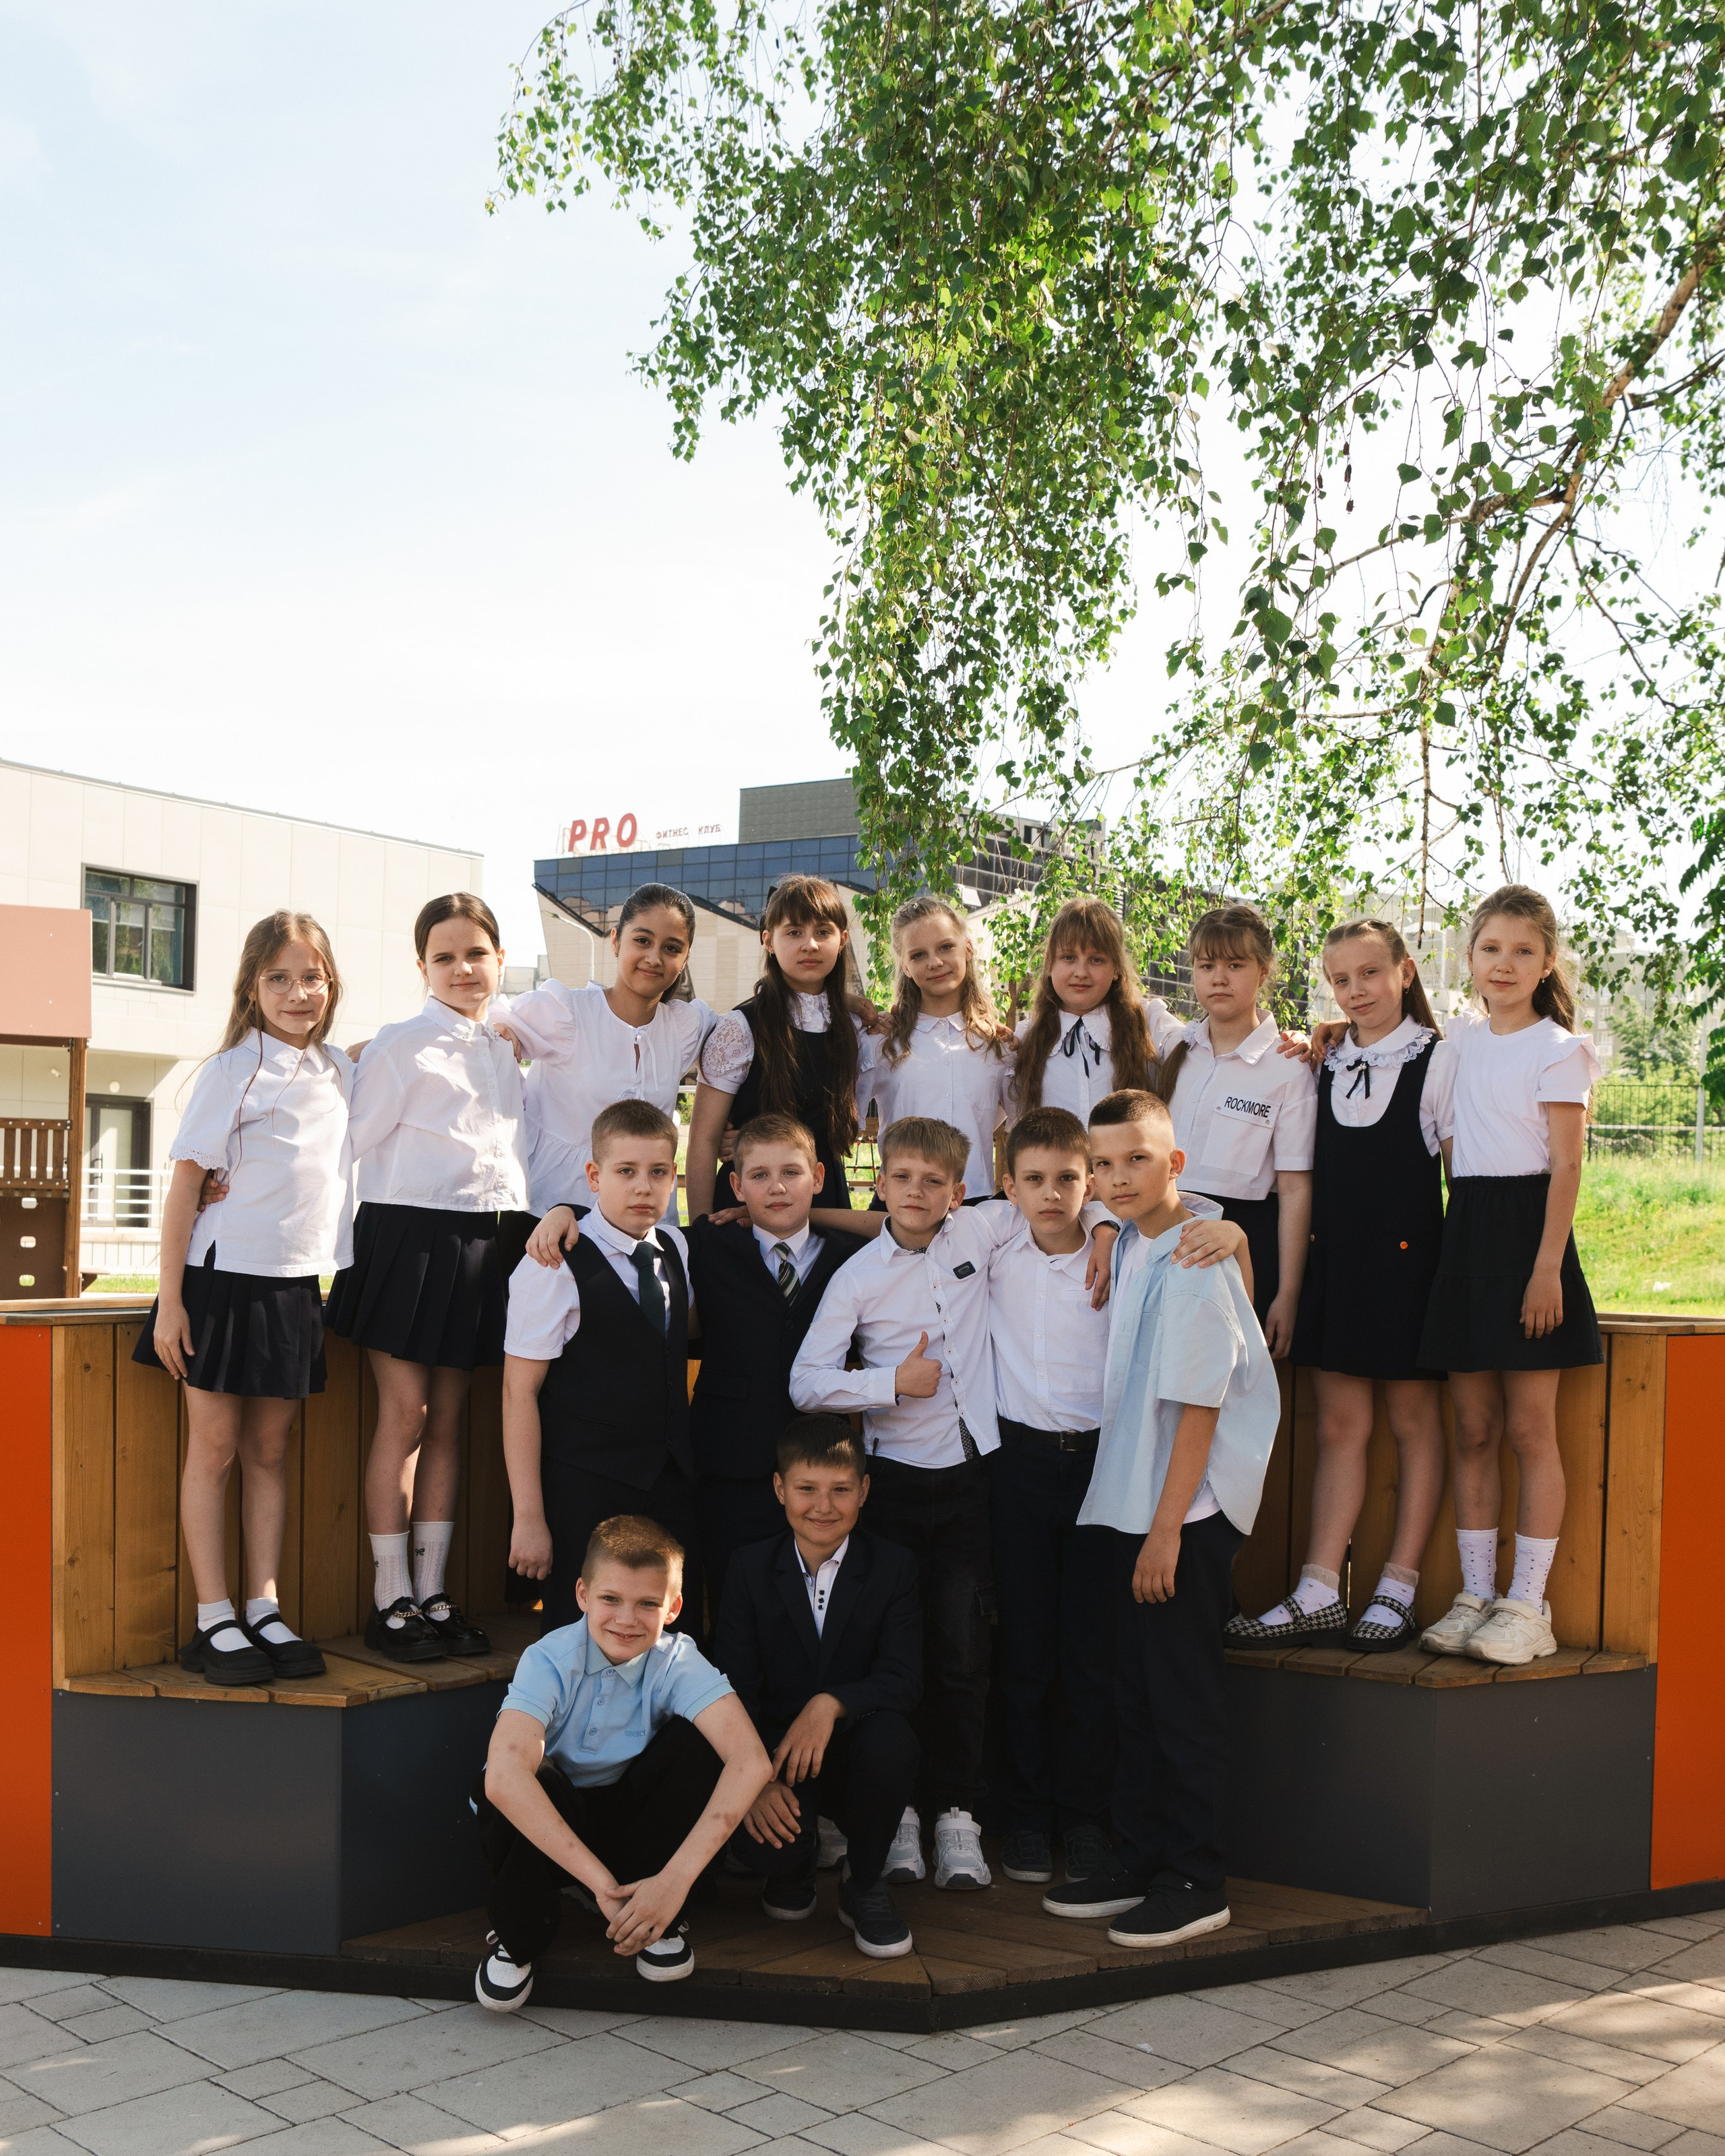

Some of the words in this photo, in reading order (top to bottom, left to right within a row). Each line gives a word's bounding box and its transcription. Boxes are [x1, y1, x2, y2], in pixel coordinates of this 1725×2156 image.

[568, 813, 637, 852] PRO
[656, 827, 689, 839] ФИТНЕС
[698, 824, 721, 835] КЛУБ
[1224, 1096, 1272, 1118] ROCKMORE
